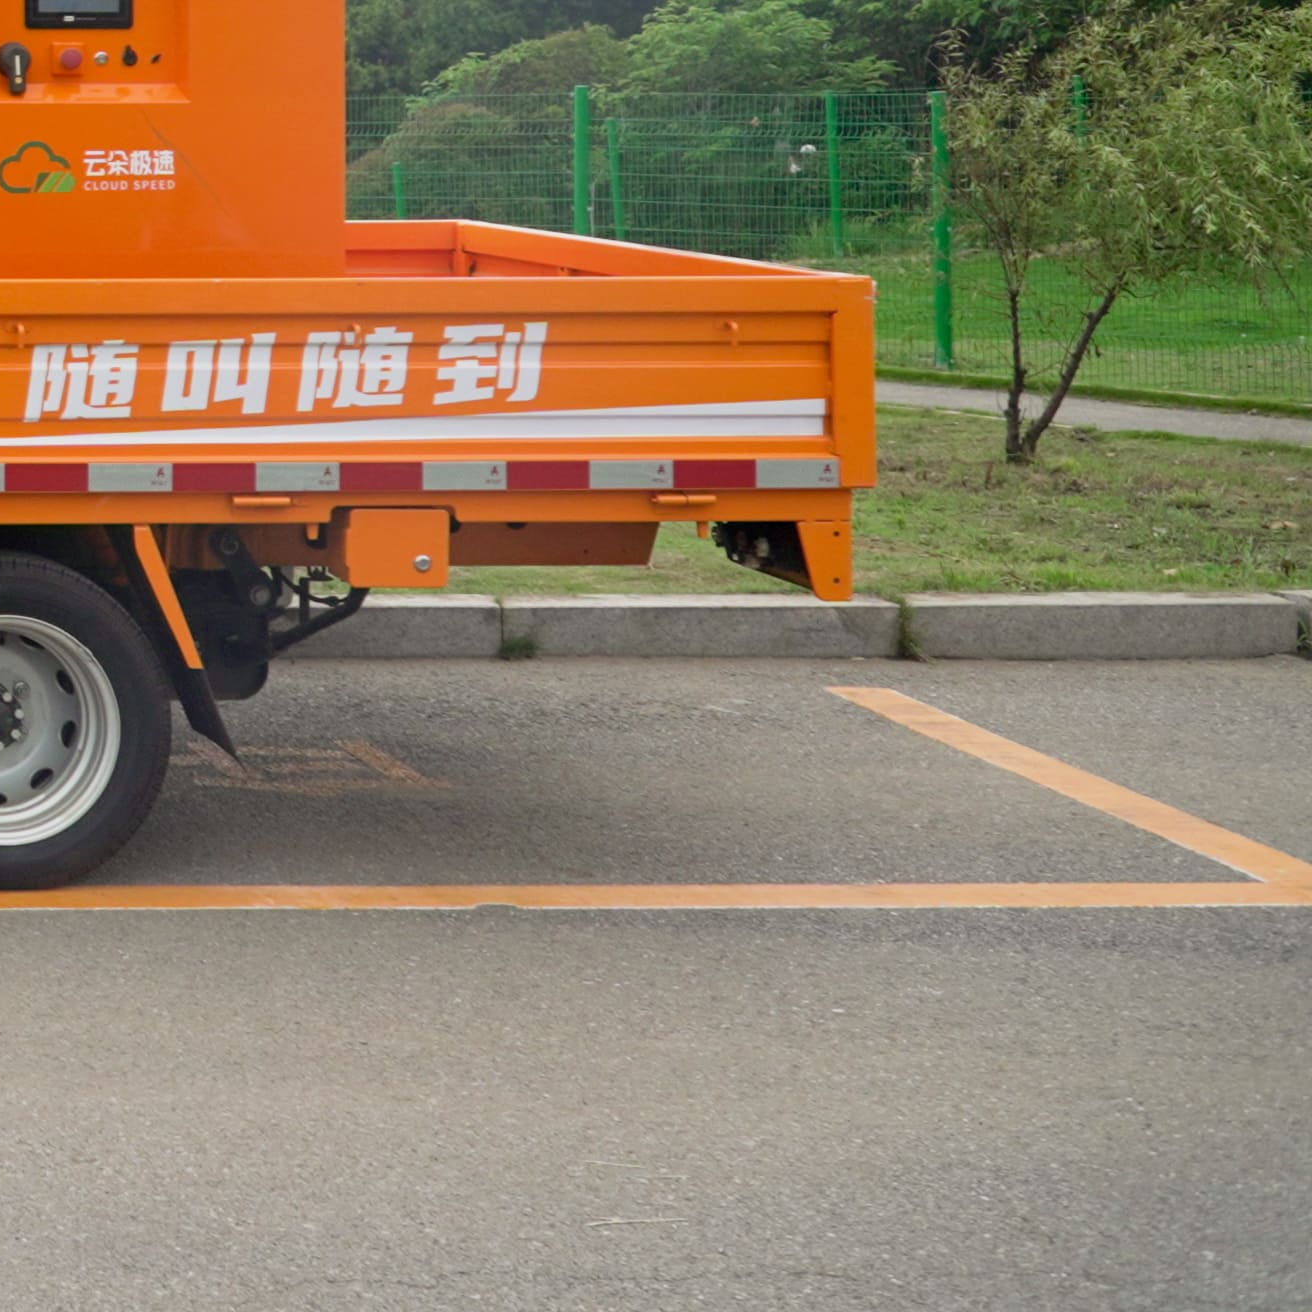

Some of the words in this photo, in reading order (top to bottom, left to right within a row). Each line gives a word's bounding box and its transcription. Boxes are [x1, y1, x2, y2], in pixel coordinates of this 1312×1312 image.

[83, 150, 175, 176] 云朵极速
[83, 180, 128, 191] CLOUD
[134, 180, 175, 190] SPEED
[23, 321, 548, 422] 随叫随到
